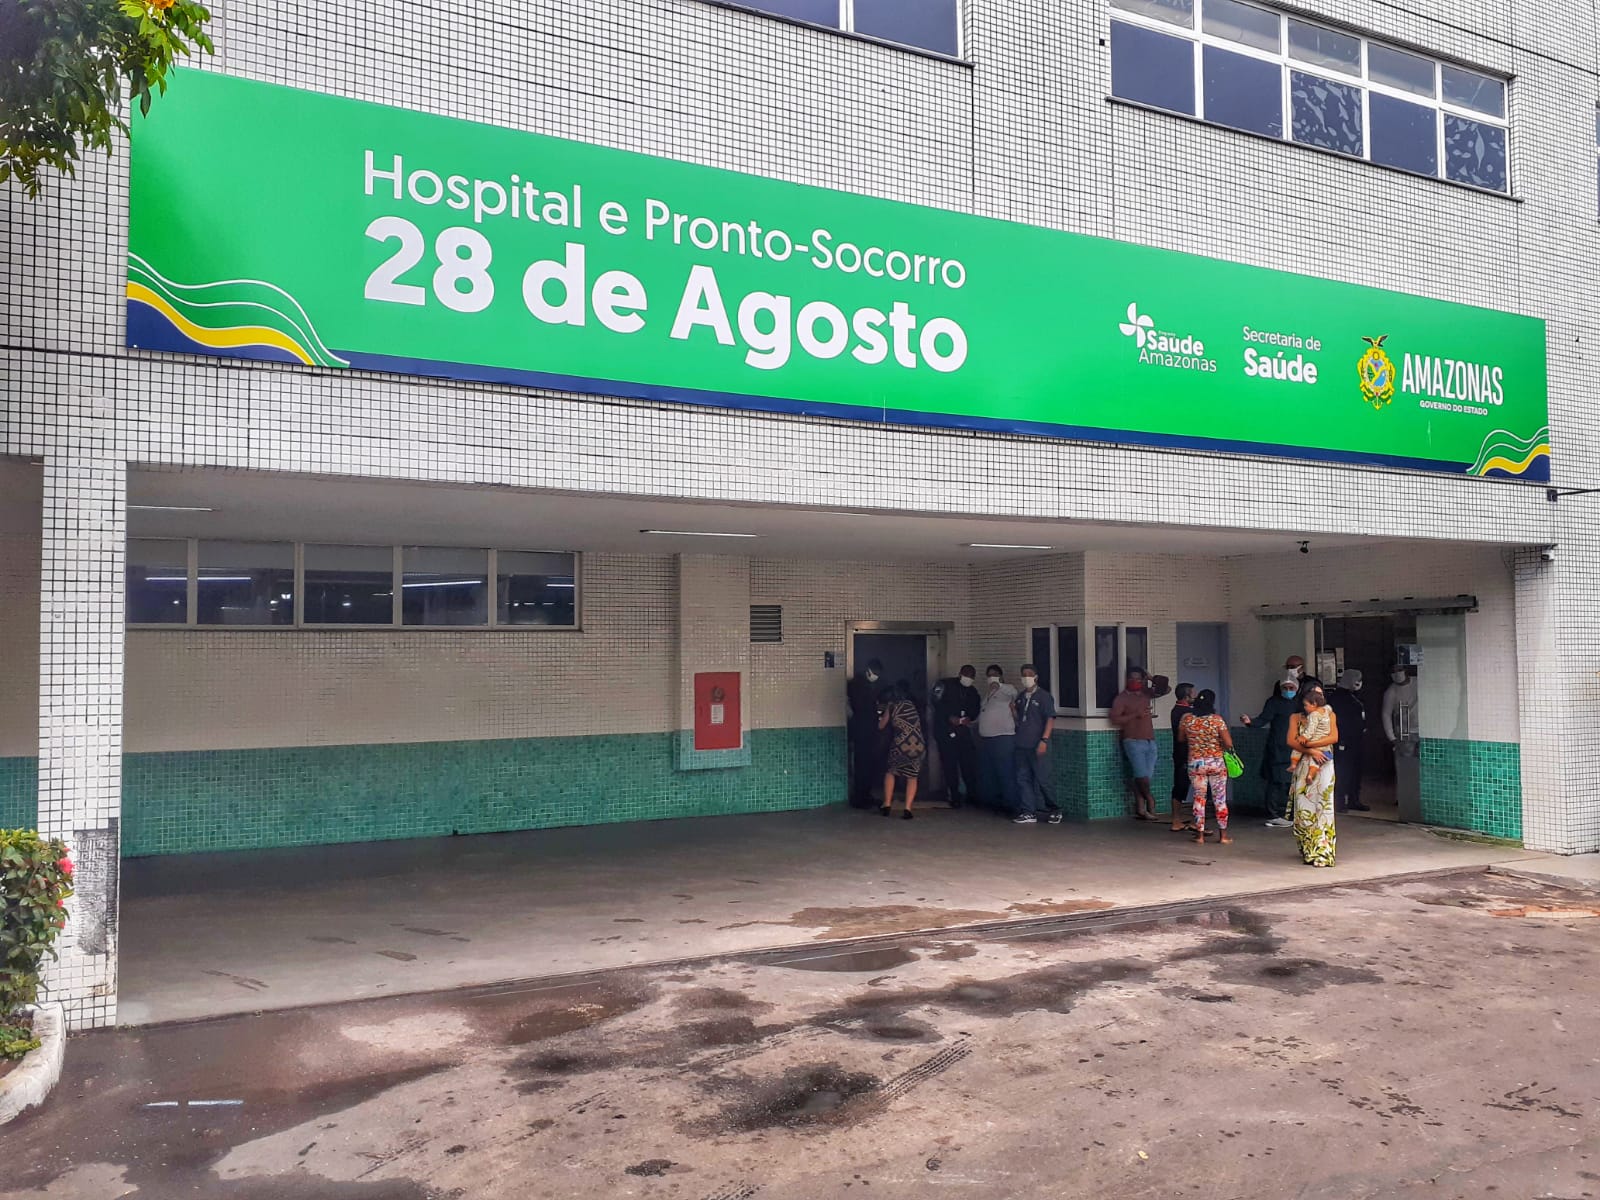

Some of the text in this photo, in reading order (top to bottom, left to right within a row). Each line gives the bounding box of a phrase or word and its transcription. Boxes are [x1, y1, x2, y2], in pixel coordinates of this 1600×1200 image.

[364, 149, 966, 289] Hospital e Pronto-Socorro
[364, 216, 968, 373] 28 de Agosto
[1242, 326, 1322, 351] Secretaria de
[1138, 347, 1217, 373] Amazonas
[1243, 347, 1318, 385] Saúde
[1401, 352, 1504, 406] AMAZONAS
[1419, 399, 1488, 416] GOVERNO DO ESTADO
